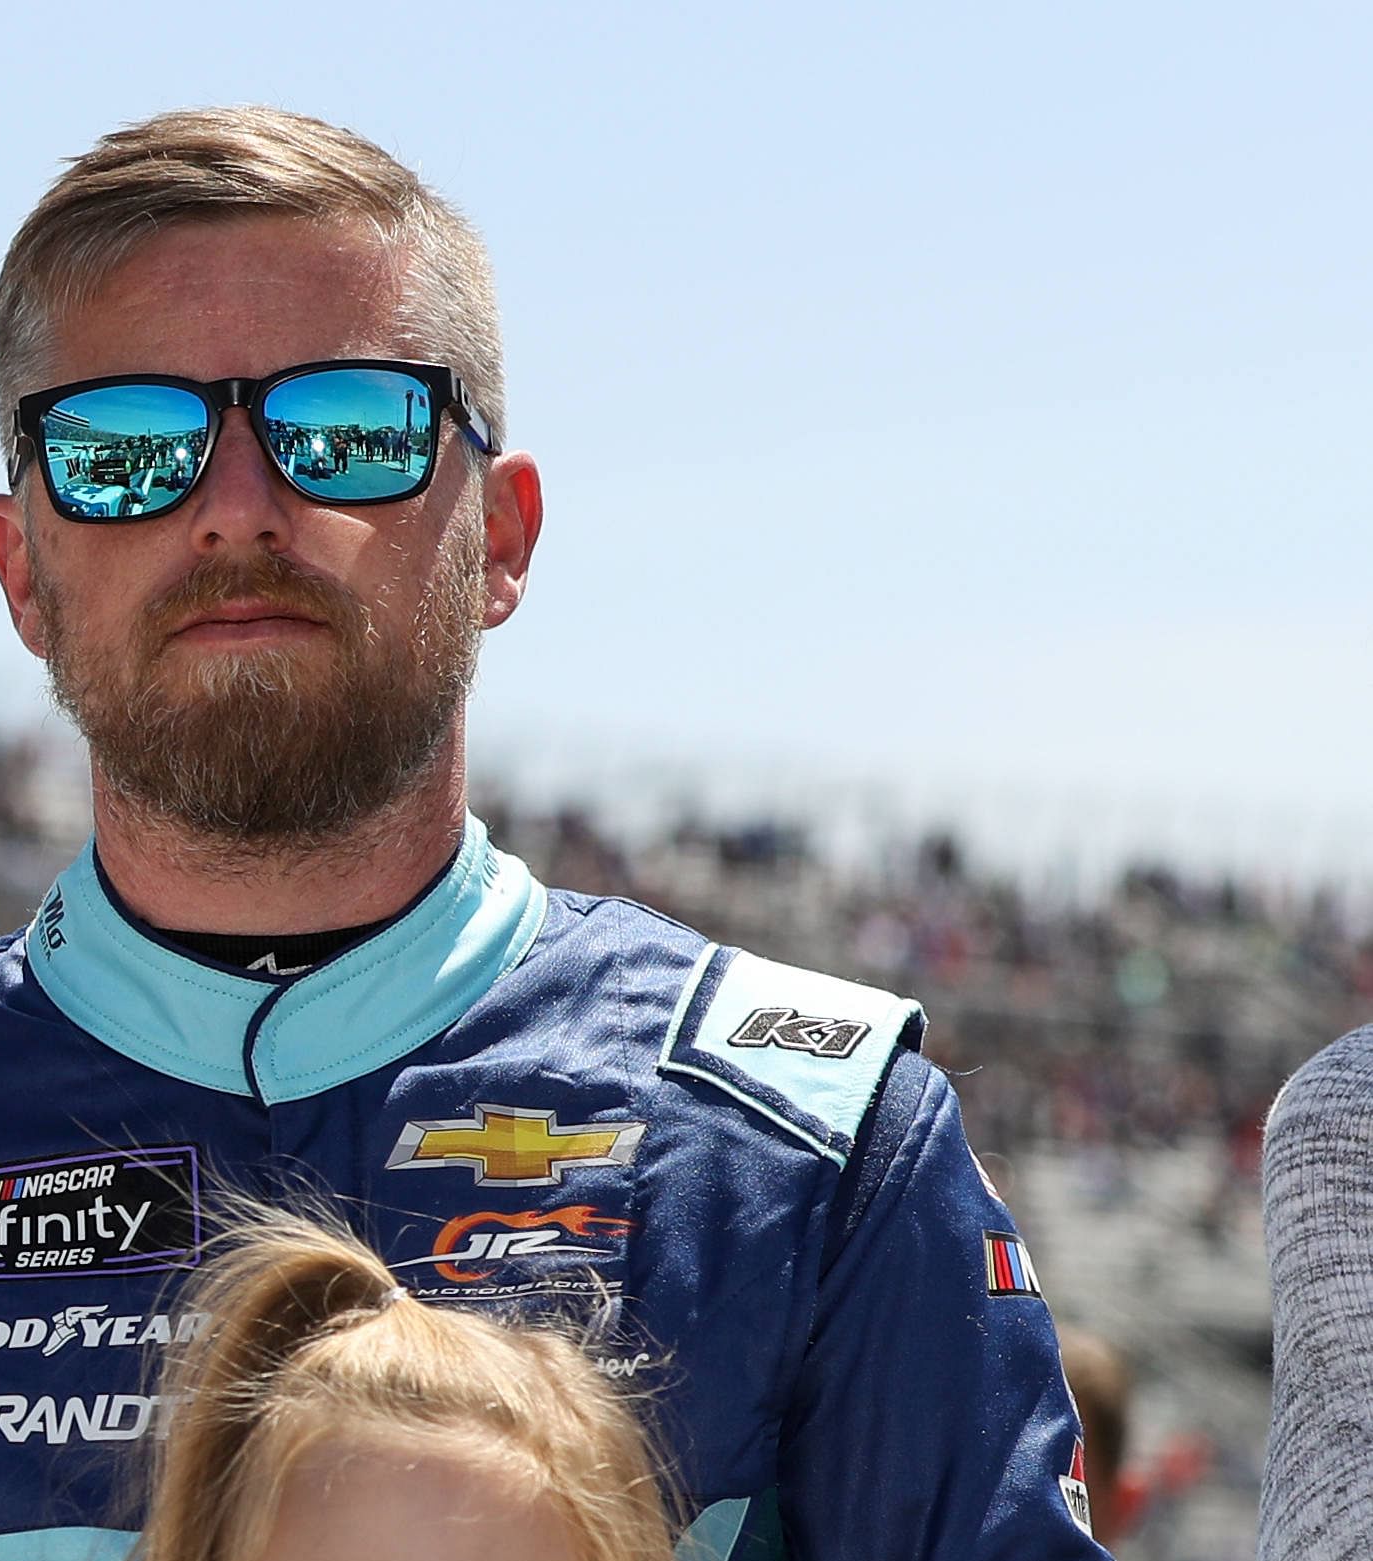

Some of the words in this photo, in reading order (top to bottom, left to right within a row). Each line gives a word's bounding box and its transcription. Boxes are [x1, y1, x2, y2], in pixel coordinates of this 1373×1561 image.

[727, 1008, 871, 1058] K1
[21, 1165, 115, 1199] NASCAR
[14, 1247, 96, 1268] SERIES
